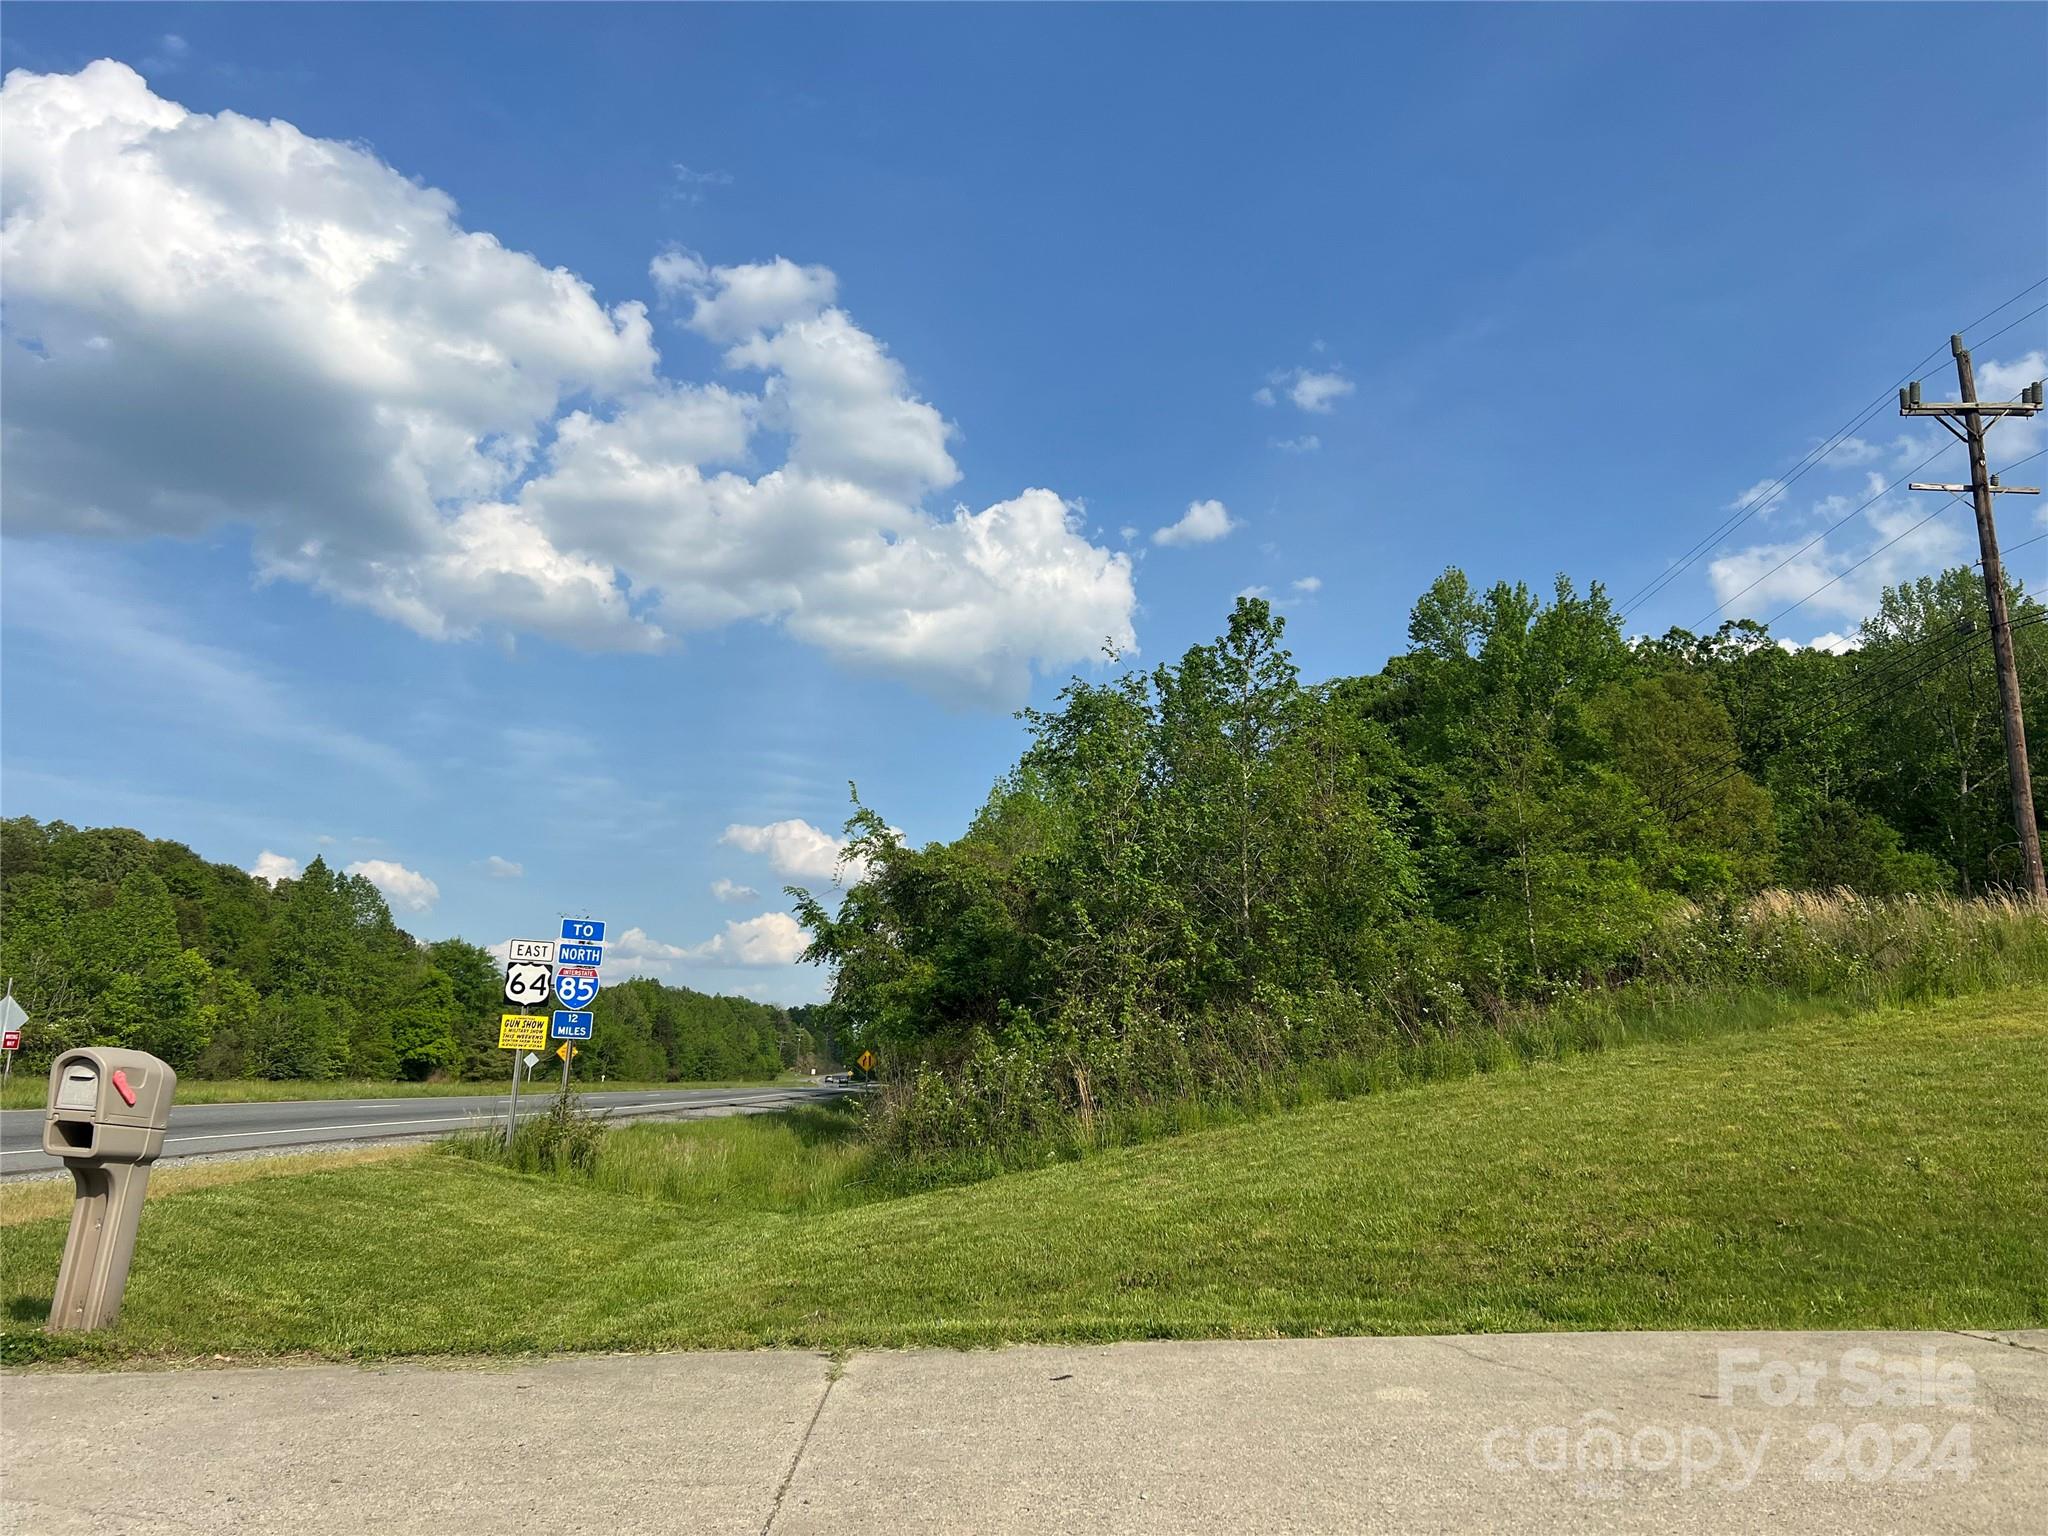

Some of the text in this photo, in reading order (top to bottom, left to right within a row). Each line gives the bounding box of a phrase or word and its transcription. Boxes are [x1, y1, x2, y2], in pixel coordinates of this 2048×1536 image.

[573, 924, 594, 937] TO
[517, 944, 548, 957] EAST
[561, 947, 600, 962] NORTH
[510, 972, 546, 996] 64
[559, 977, 594, 1001] 85
[504, 1019, 545, 1029] GUN SHOW
[568, 1013, 578, 1023] 12
[557, 1026, 586, 1036] MILES
